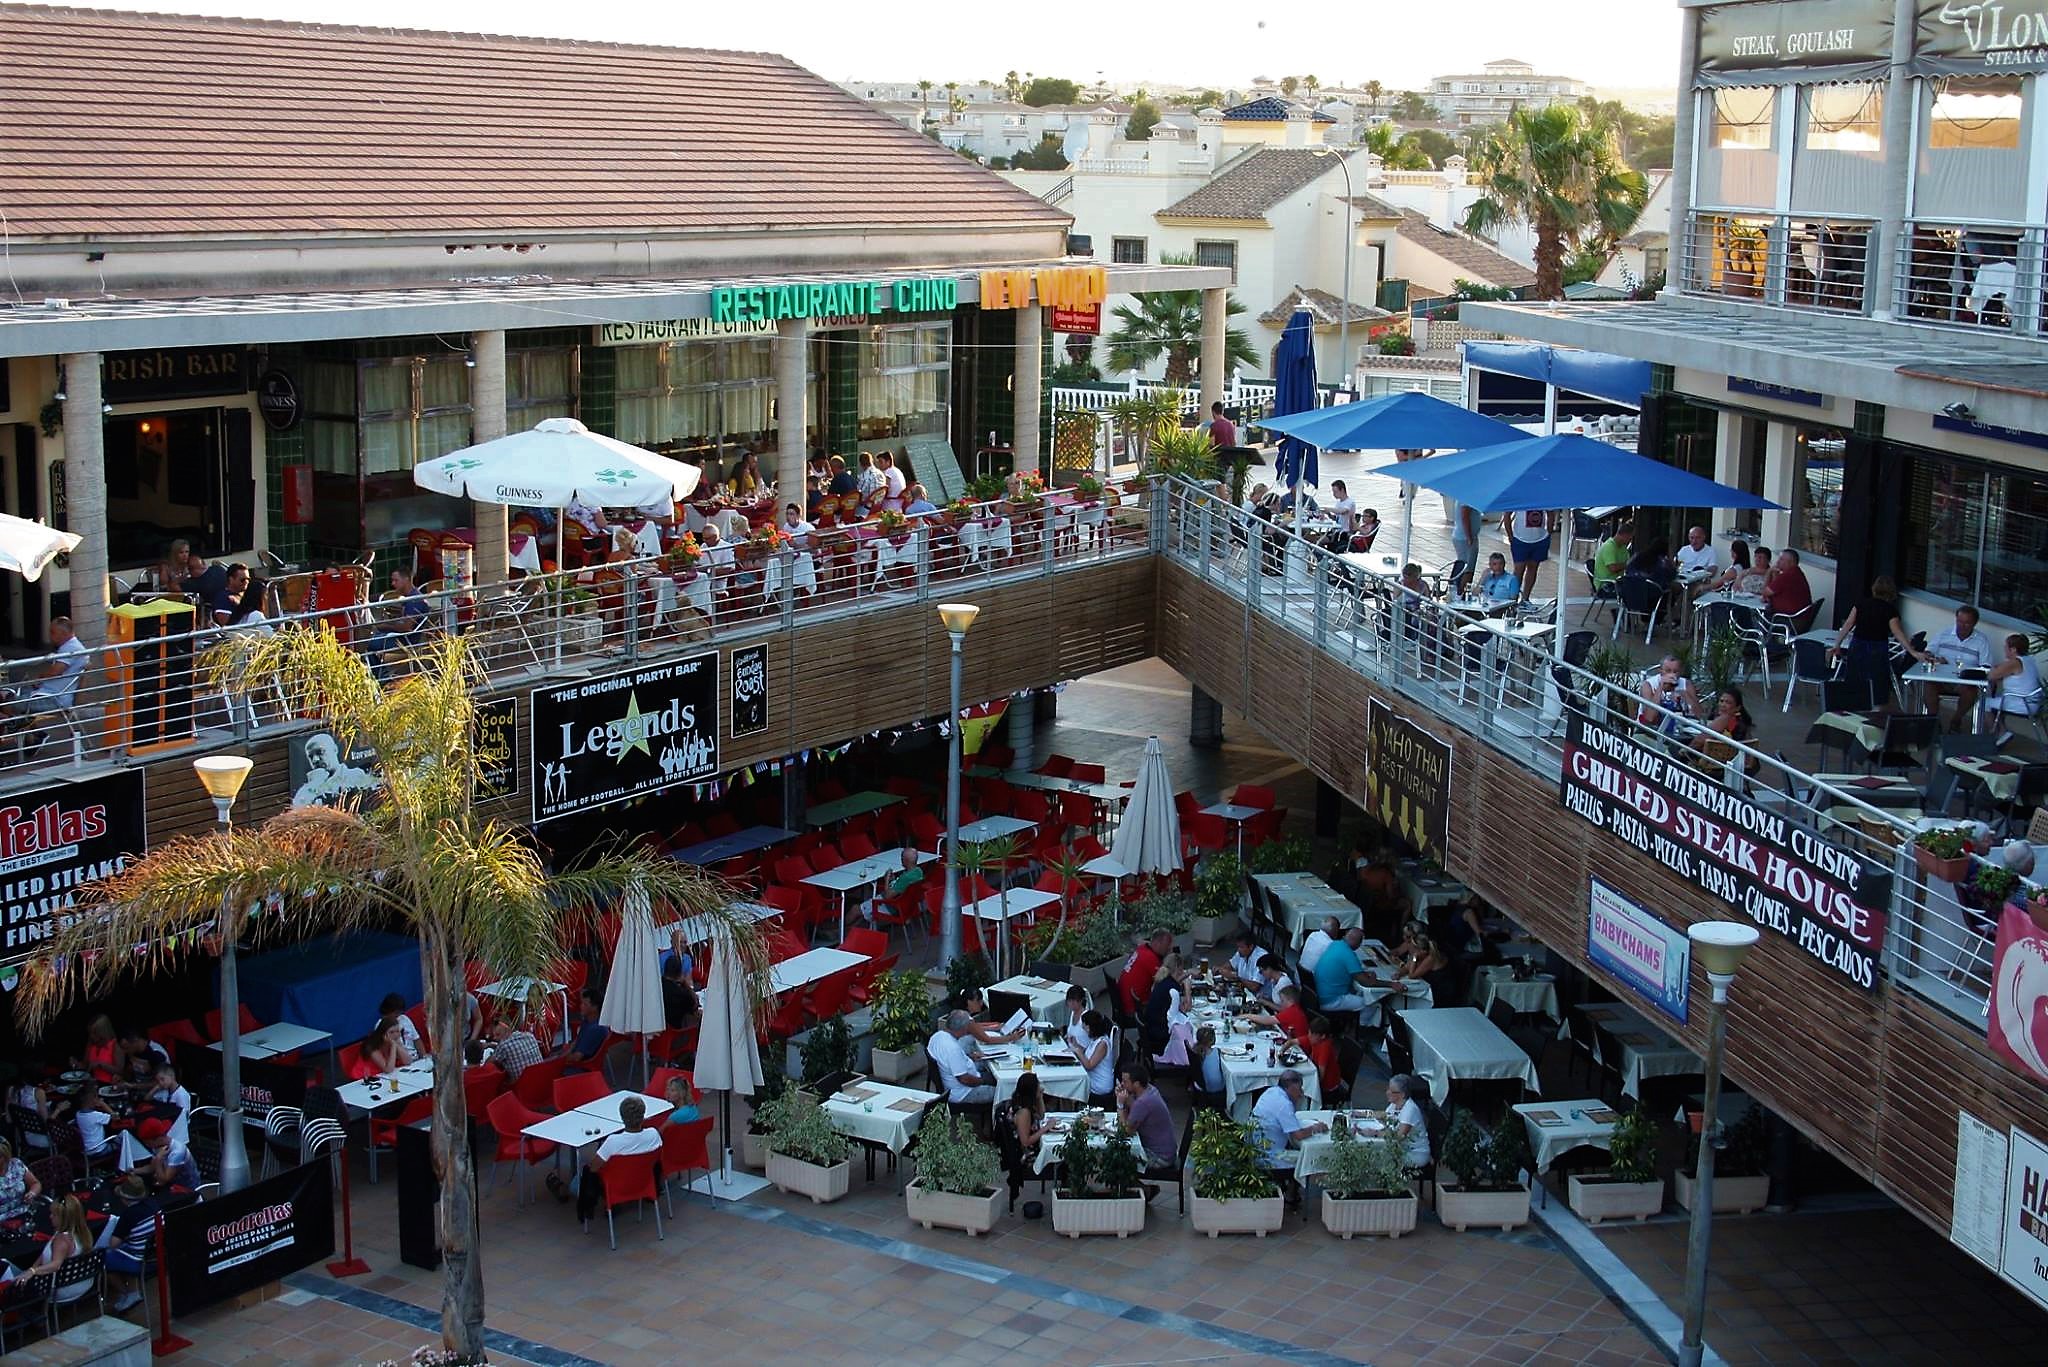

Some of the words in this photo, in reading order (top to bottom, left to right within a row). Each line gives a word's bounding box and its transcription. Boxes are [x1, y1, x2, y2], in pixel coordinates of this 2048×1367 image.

[1732, 36, 1780, 57] STEAK,
[1786, 29, 1855, 53] GOULASH
[1984, 50, 2034, 66] STEAK
[2035, 48, 2046, 64] &
[712, 282, 882, 322] RESTAURANTE
[893, 278, 958, 312] CHINO
[980, 270, 1031, 310] NEW
[110, 352, 173, 381] RISH
[187, 351, 237, 376] BAR
[496, 484, 543, 500] GUINNESS
[581, 677, 633, 697] ORIGINAL
[636, 668, 673, 686] PARTY
[481, 707, 514, 728] Good
[559, 698, 696, 760] Legends
[481, 725, 505, 745] Pub
[1415, 743, 1443, 784] THAI
[542, 806, 556, 815] THE
[558, 800, 578, 811] HOME
[580, 797, 590, 805] OF
[649, 776, 663, 786] LIVE
[665, 770, 691, 782] SPORTS
[692, 763, 714, 775] SHOWN
[1581, 722, 1663, 783] HOMEMADE
[1664, 764, 1787, 848] INTERNATIONAL
[2, 861, 17, 871] THE
[20, 856, 42, 867] BEST
[1572, 751, 1669, 824] GRILLED
[1675, 806, 1759, 876] STEAK
[1763, 852, 1872, 944] HOUSE
[0, 877, 45, 904] LED
[50, 855, 127, 891] STEAKS
[9, 891, 75, 924] PASTA
[1612, 807, 1649, 851] PASTAS
[1654, 833, 1690, 878] PIZZAS
[1699, 859, 1737, 904] TAPAS
[1799, 916, 1873, 989] PESCADOS
[6, 919, 54, 948] FINE
[1595, 912, 1661, 971] BABYCHAMS
